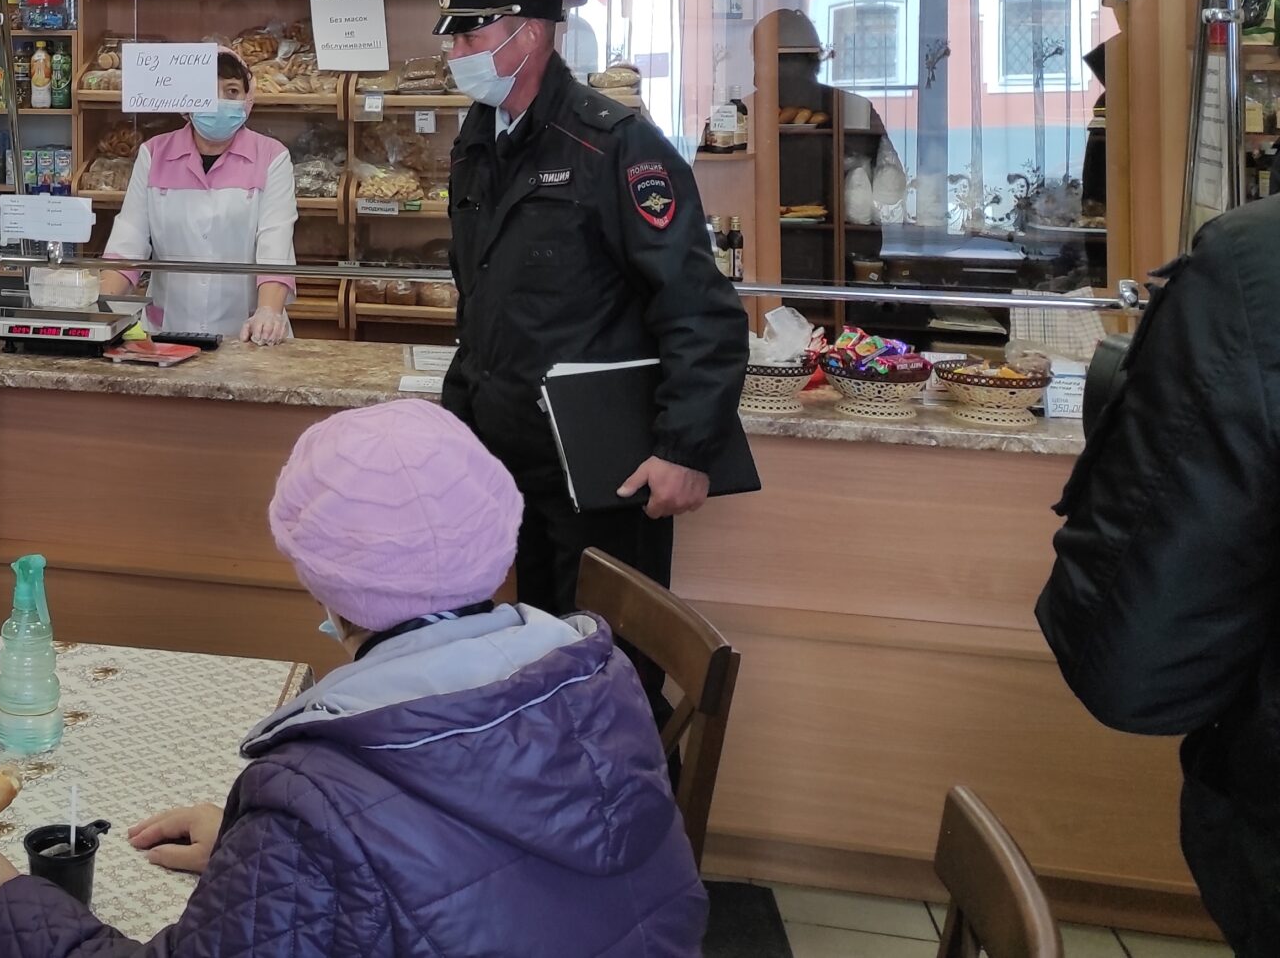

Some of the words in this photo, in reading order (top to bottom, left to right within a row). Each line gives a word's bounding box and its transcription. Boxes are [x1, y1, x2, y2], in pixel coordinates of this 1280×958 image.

[329, 16, 342, 24] Без
[321, 40, 382, 51] обслуживаем!!!
[136, 51, 160, 72] Без
[169, 53, 212, 66] маски
[155, 76, 173, 87] не
[129, 92, 213, 112] обслуживаем
[630, 163, 664, 176] ПОЛИЦИЯ
[637, 179, 666, 192] РОССИЯ
